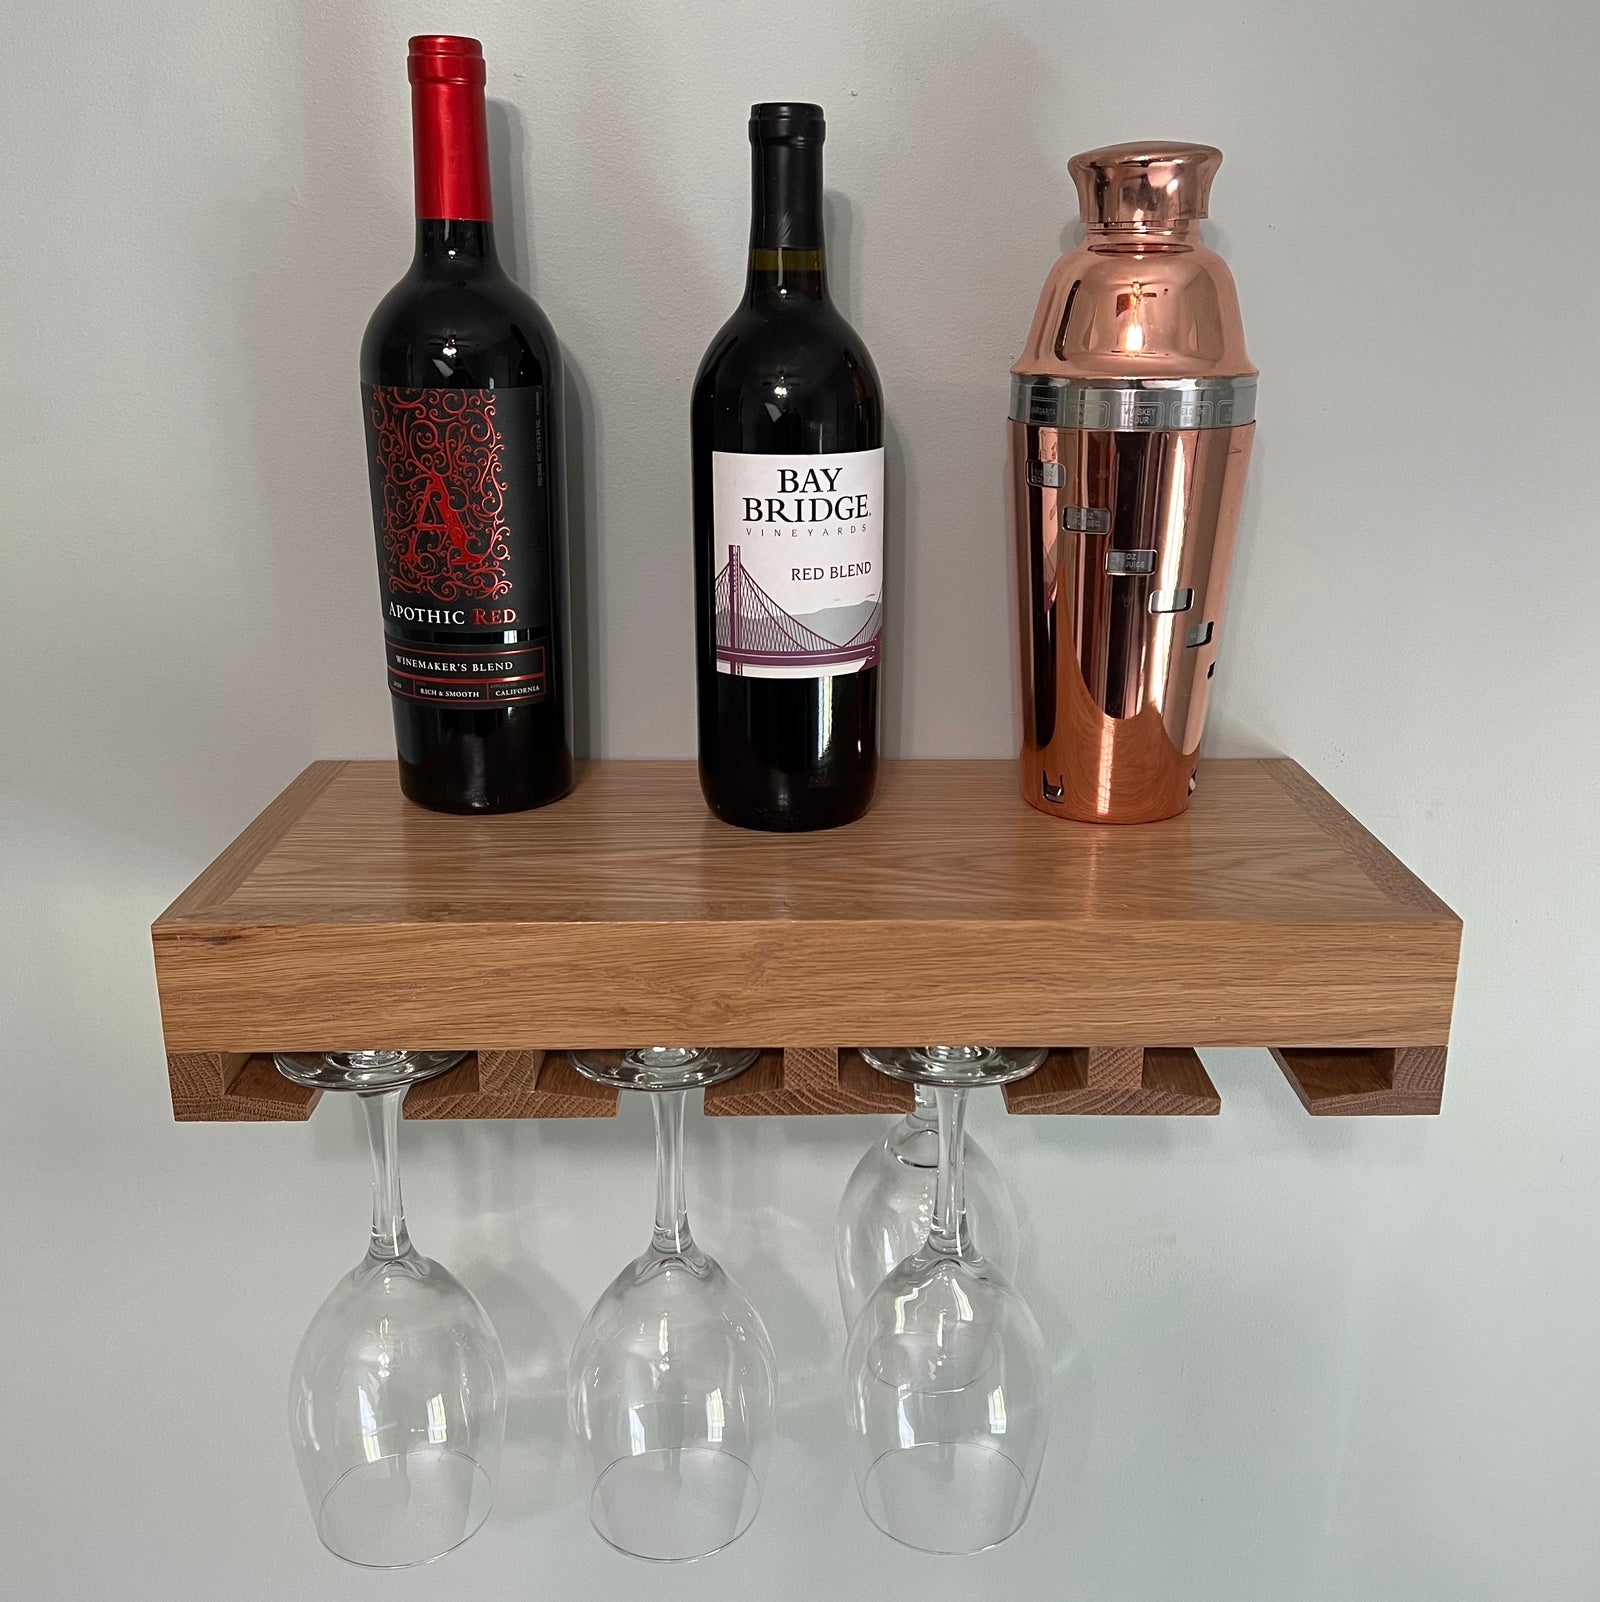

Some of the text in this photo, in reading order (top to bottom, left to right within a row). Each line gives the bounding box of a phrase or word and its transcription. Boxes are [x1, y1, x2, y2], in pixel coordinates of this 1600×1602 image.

[777, 467, 843, 494] BAY
[746, 524, 867, 537] VINEYARDS
[791, 561, 872, 581] RED BLEND
[389, 601, 517, 626] APOTHIC RED
[395, 655, 513, 672] WINEMAKER'S BLEND
[420, 687, 437, 696] RICH
[445, 690, 480, 698] SMOOTH
[495, 685, 540, 697] CALIFORNIA
